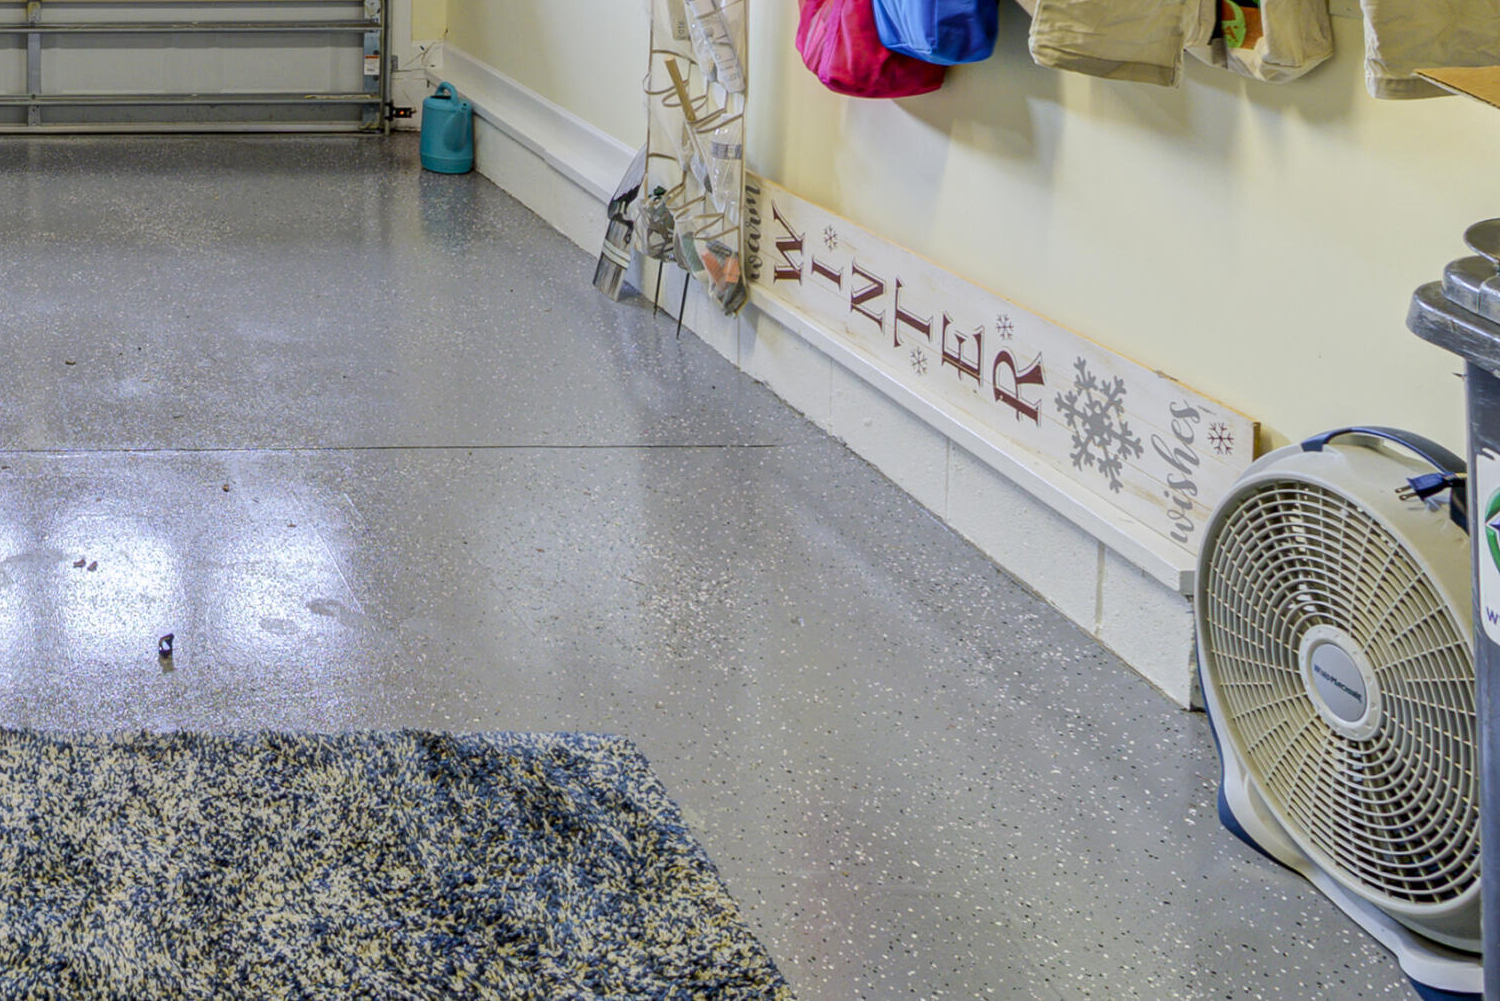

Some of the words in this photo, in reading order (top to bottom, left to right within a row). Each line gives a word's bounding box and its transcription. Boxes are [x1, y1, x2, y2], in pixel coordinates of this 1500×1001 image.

[745, 184, 763, 281] warm
[772, 200, 1046, 429] WINTER
[1151, 399, 1202, 544] wishes
